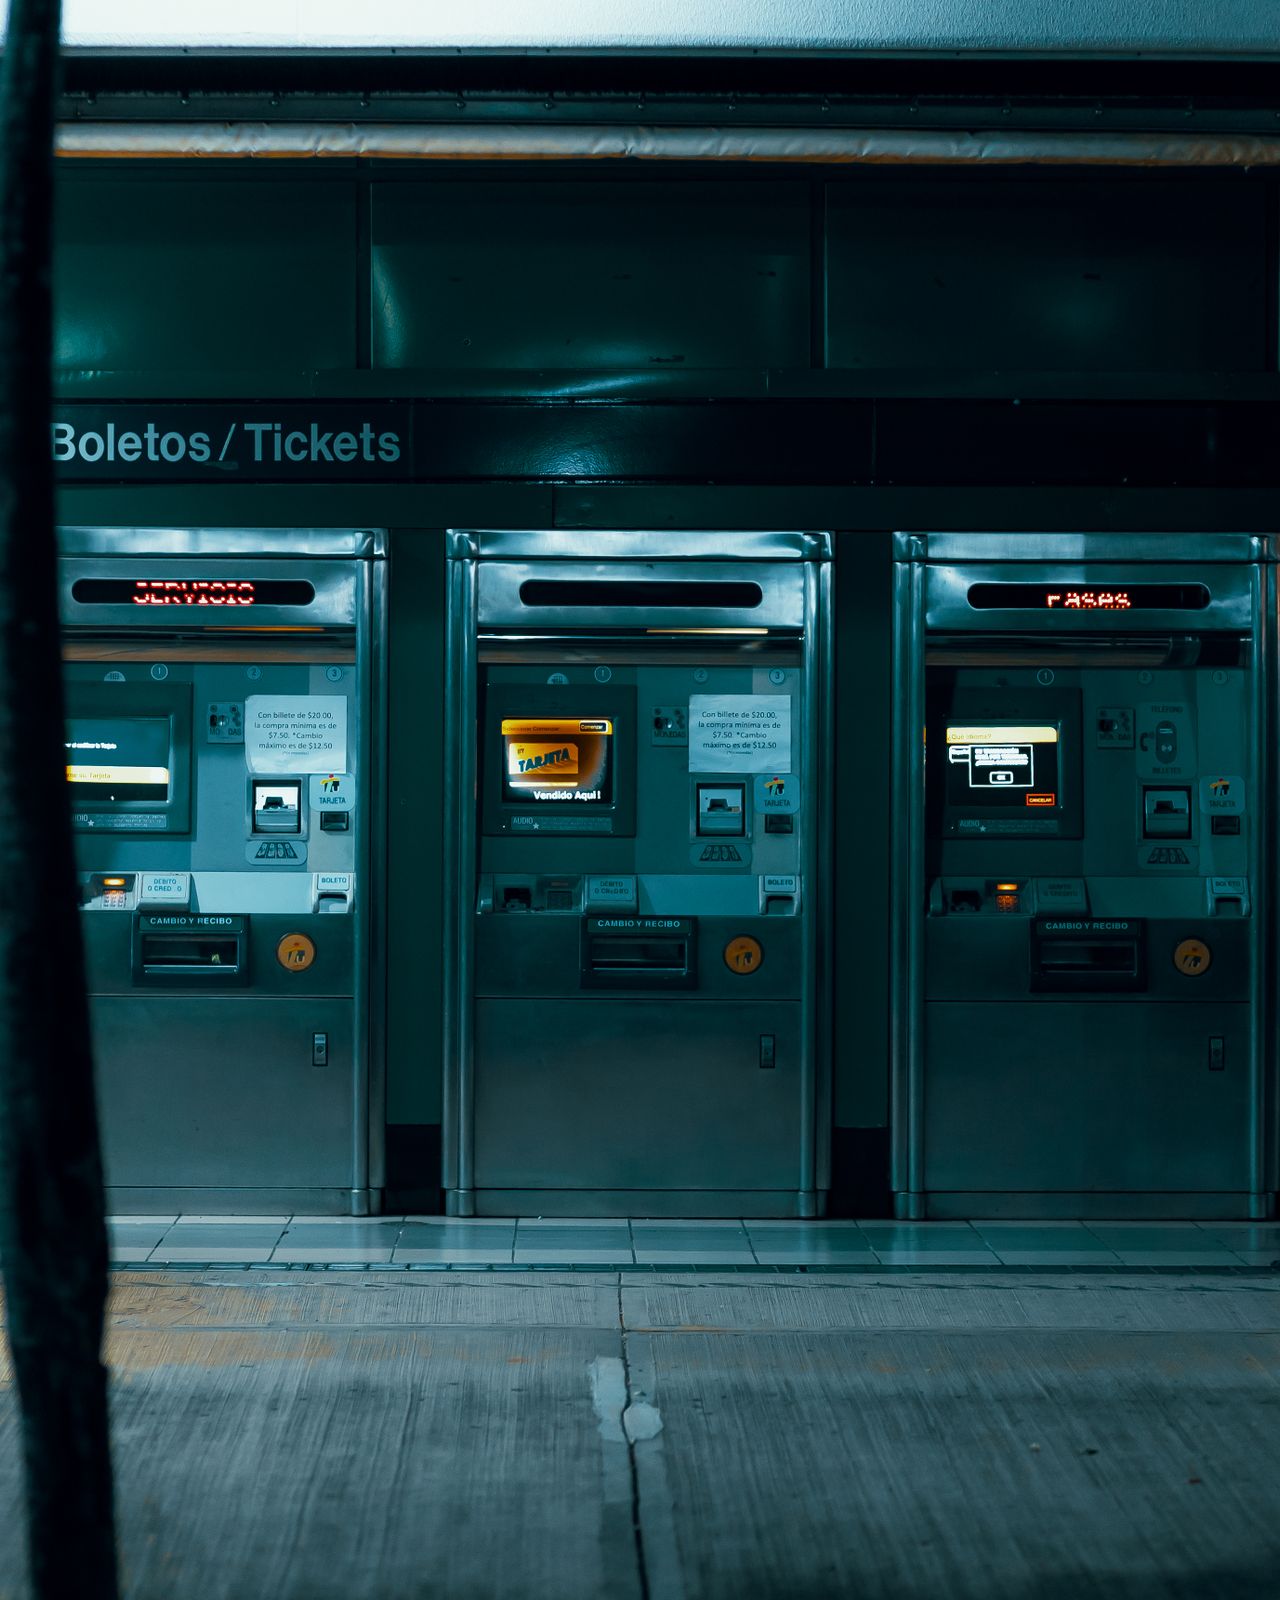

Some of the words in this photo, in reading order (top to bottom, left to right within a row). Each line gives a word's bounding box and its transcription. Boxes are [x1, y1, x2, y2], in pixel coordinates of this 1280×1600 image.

[52, 422, 211, 462] Boletos
[218, 423, 237, 461] /
[244, 423, 401, 462] Tickets
[273, 711, 296, 719] billete
[701, 711, 716, 719] Con
[740, 711, 750, 719] de
[751, 711, 778, 720] $20.00,
[308, 742, 333, 750] $12.50
[702, 741, 731, 749] máximo
[752, 741, 777, 750] $12.50
[533, 790, 573, 800] Vendido
[319, 796, 346, 804] TARJETA
[763, 799, 791, 807] TARJETA
[320, 876, 347, 884] BOLETO
[767, 878, 794, 886] BOLETO
[149, 917, 187, 925] CAMBIO
[188, 917, 194, 925] Y
[197, 917, 233, 926] RECIBO
[597, 919, 635, 928] CAMBIO
[636, 920, 642, 928] Y
[645, 920, 681, 928] RECIBO
[1045, 922, 1082, 931] CAMBIO
[1083, 922, 1090, 931] Y
[1092, 922, 1129, 931] RECIBO
